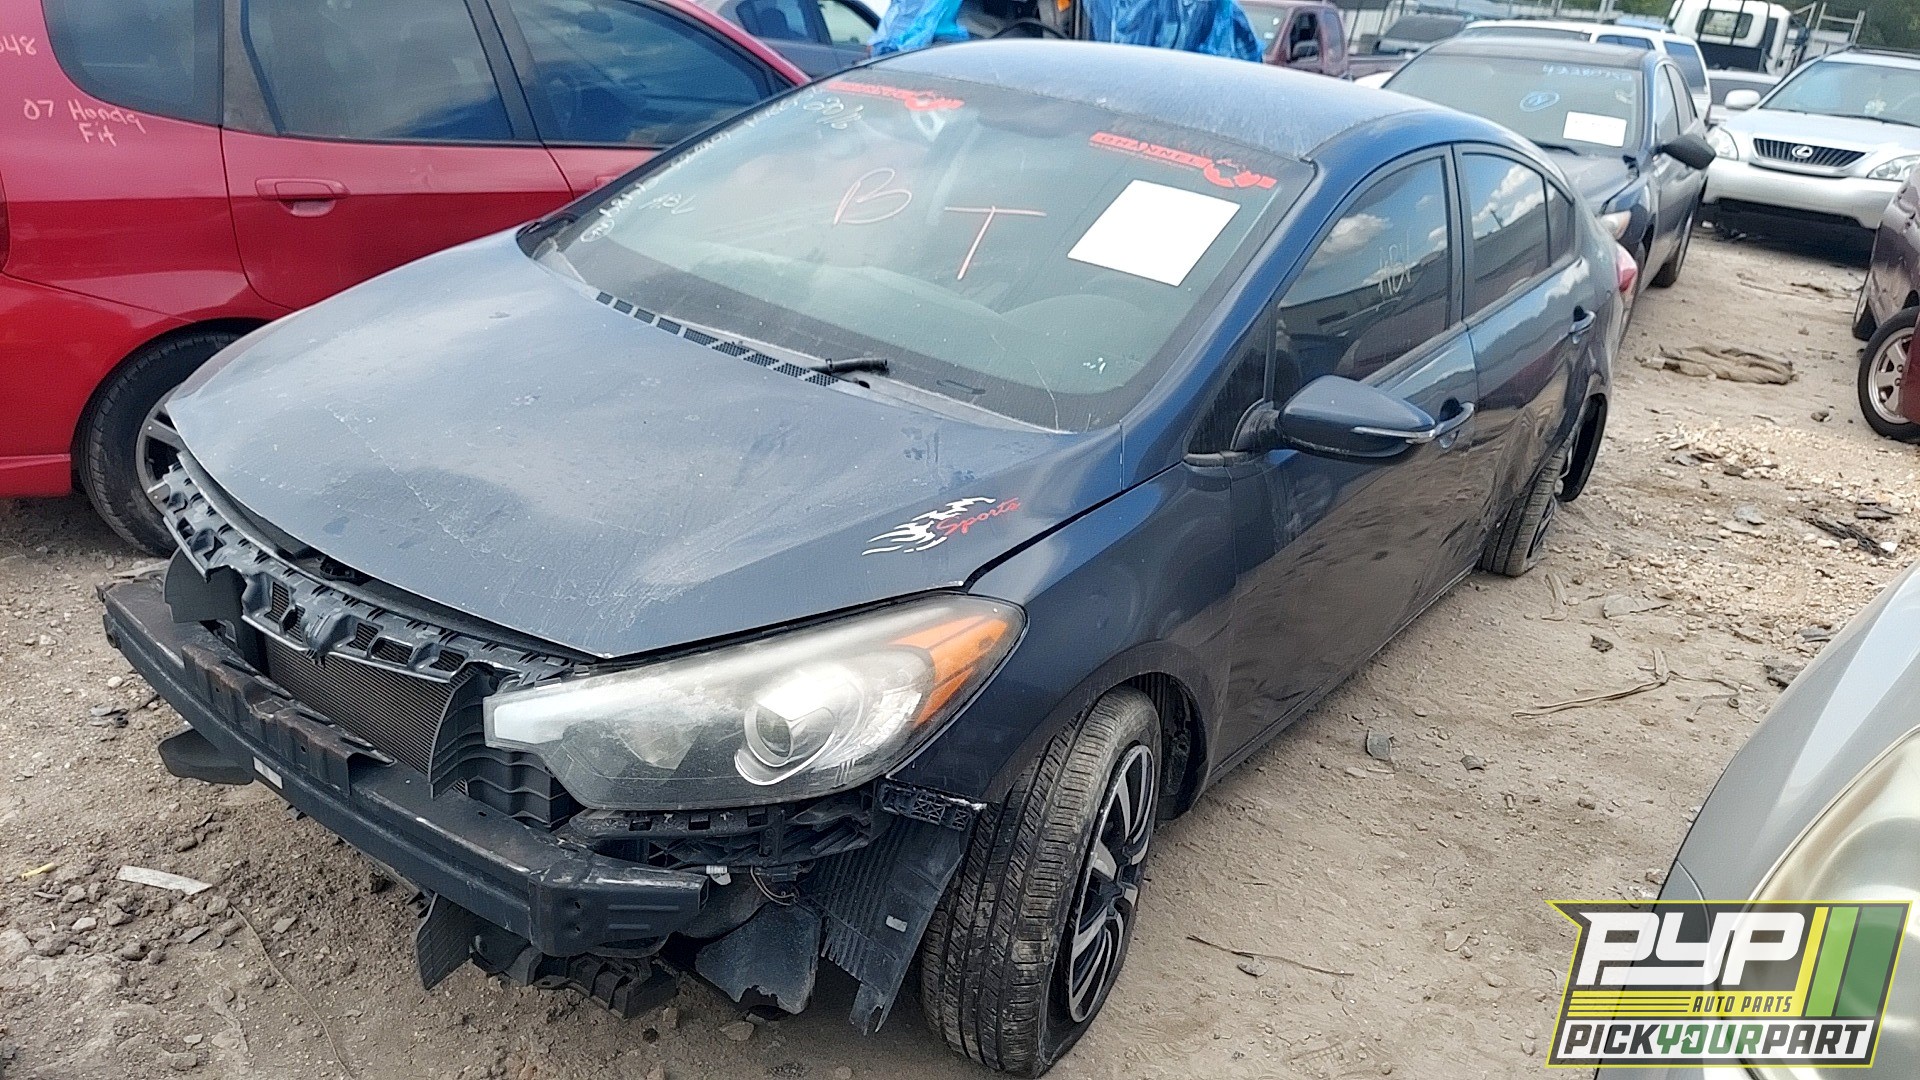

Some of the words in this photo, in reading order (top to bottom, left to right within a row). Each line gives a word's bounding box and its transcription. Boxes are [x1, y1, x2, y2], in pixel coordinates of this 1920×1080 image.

[23, 98, 55, 120] 07
[67, 98, 147, 135] Honda
[78, 121, 117, 147] Fit
[833, 166, 913, 226] B
[943, 204, 1048, 281] T
[936, 496, 1022, 537] Sports
